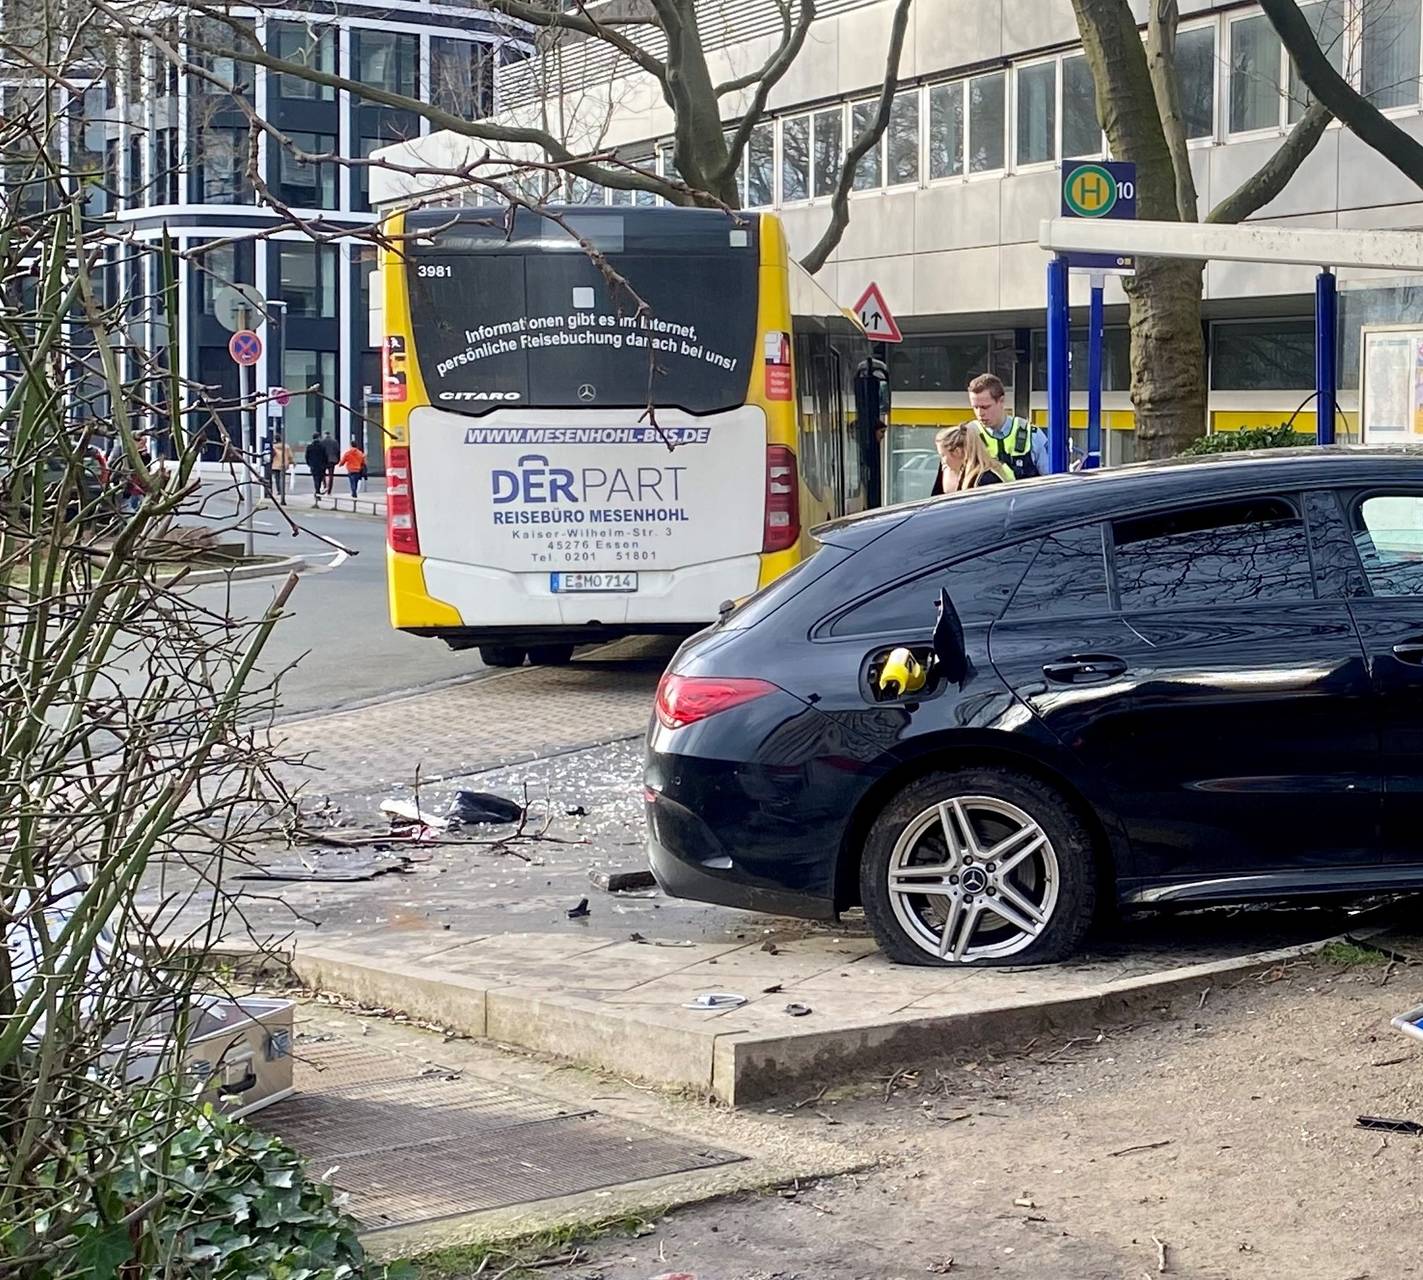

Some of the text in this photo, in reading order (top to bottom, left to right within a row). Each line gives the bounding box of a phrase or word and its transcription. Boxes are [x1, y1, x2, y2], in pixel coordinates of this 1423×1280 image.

[1117, 182, 1134, 199] 10
[418, 265, 452, 277] 3981
[567, 312, 595, 329] gibt
[599, 315, 616, 327] es
[620, 316, 637, 328] im
[436, 338, 518, 377] persönliche
[520, 331, 622, 349] Reisebuchung
[680, 341, 703, 359] bei
[705, 351, 737, 371] uns!
[439, 392, 521, 400] CITARO
[467, 428, 708, 443] WWW.MESENHOHL-BUS.DE
[493, 508, 689, 525] REISEBÜRO MESENHOHL
[512, 527, 673, 539] Kaiser-Wilhelm-Str. 3
[548, 540, 639, 550] 45276 Essen
[565, 552, 596, 562] 0201
[616, 551, 657, 561] 51801
